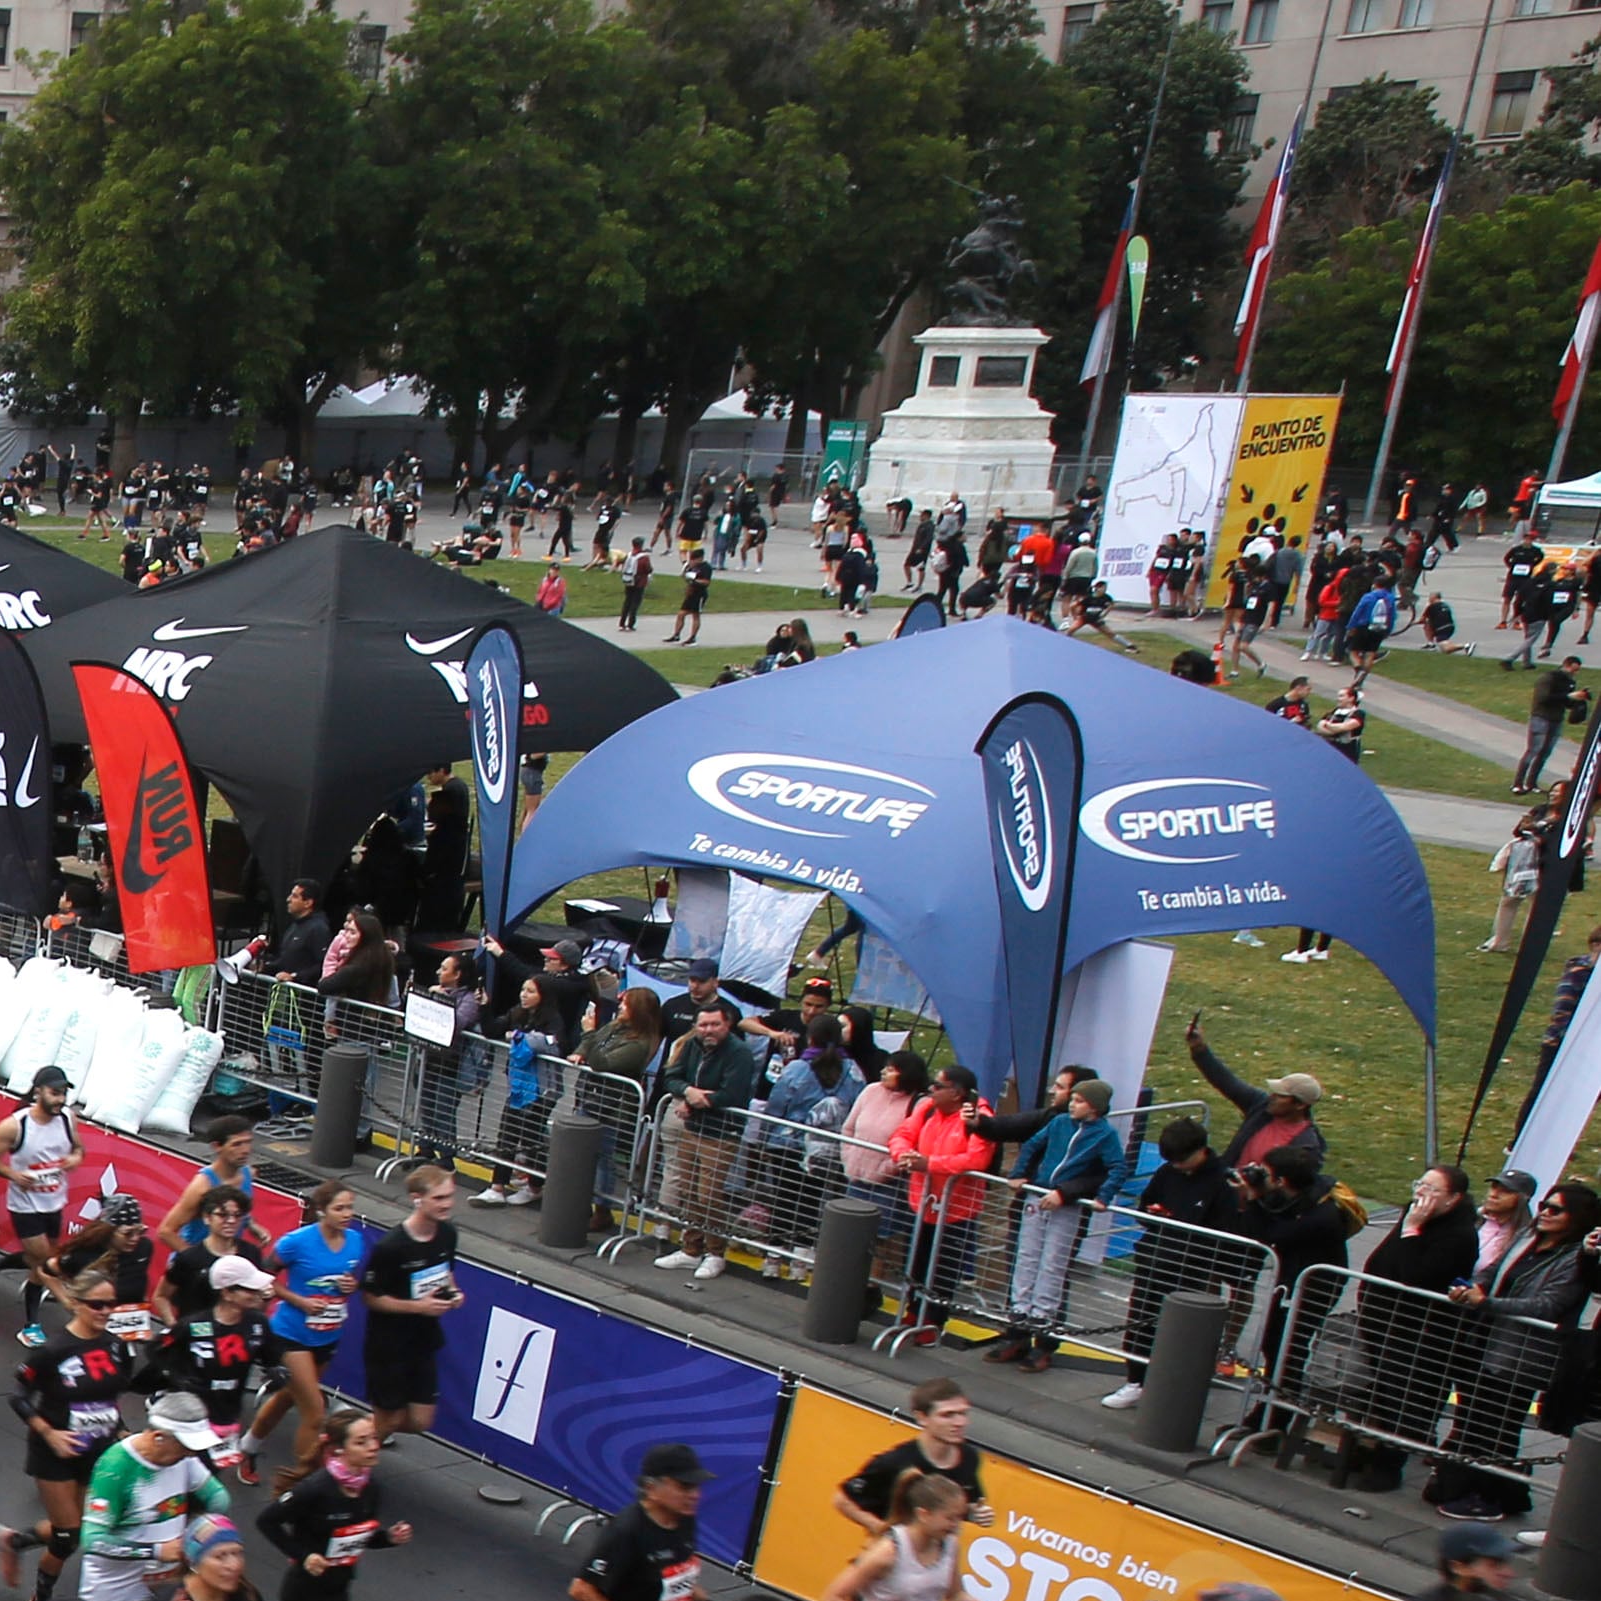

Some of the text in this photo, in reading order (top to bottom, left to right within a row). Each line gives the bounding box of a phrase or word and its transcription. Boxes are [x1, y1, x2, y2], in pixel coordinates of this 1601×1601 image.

[1240, 433, 1326, 460] ENCUENTRO
[1251, 416, 1322, 441] PUNTO DE
[120, 647, 214, 701] NRC
[730, 768, 930, 831] SPORTLIFE
[1118, 801, 1276, 841] SPORTLIFE
[687, 833, 865, 895] Te cambia la vida.
[1139, 883, 1287, 911] Te cambia la vida.
[1006, 1511, 1179, 1595] Vivamos bien
